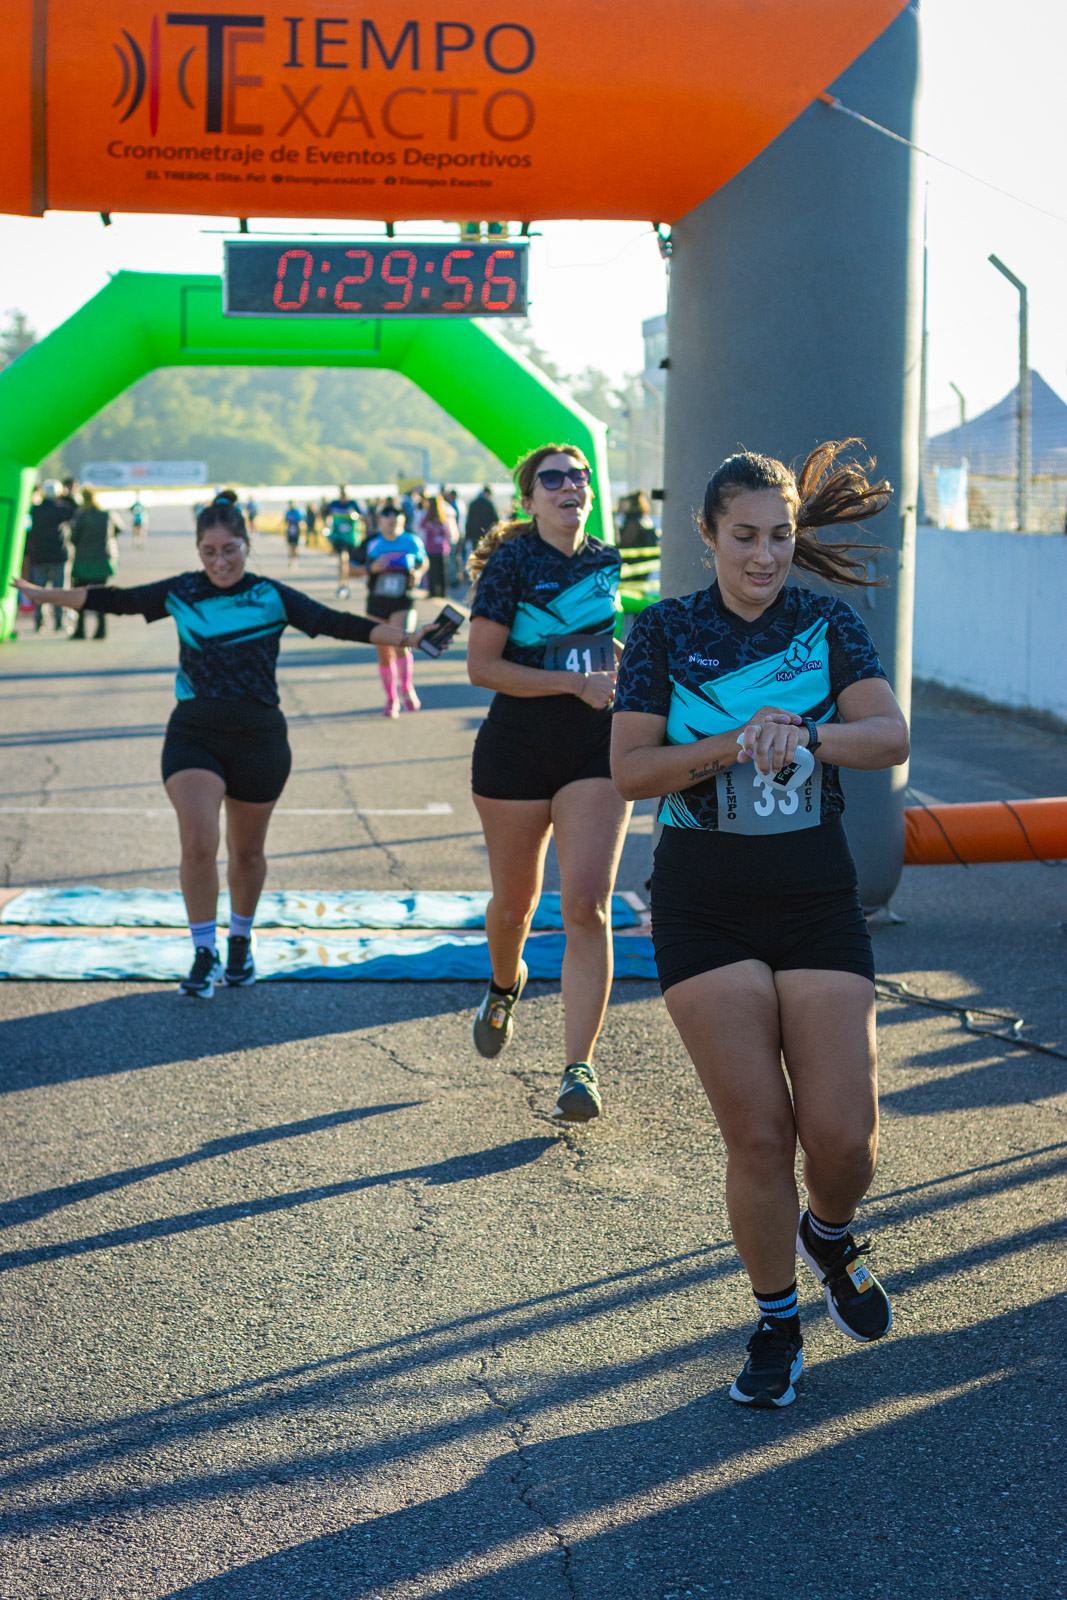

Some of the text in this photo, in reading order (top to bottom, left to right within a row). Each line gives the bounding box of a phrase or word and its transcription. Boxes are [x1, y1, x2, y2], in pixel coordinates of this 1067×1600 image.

[107, 140, 532, 169] Cronometraje de Eventos Deportivos
[273, 250, 517, 310] 0:29:56
[565, 648, 592, 673] 41
[723, 771, 737, 820] TIEMPO
[753, 773, 799, 816] 33
[804, 776, 813, 812] ACTO
